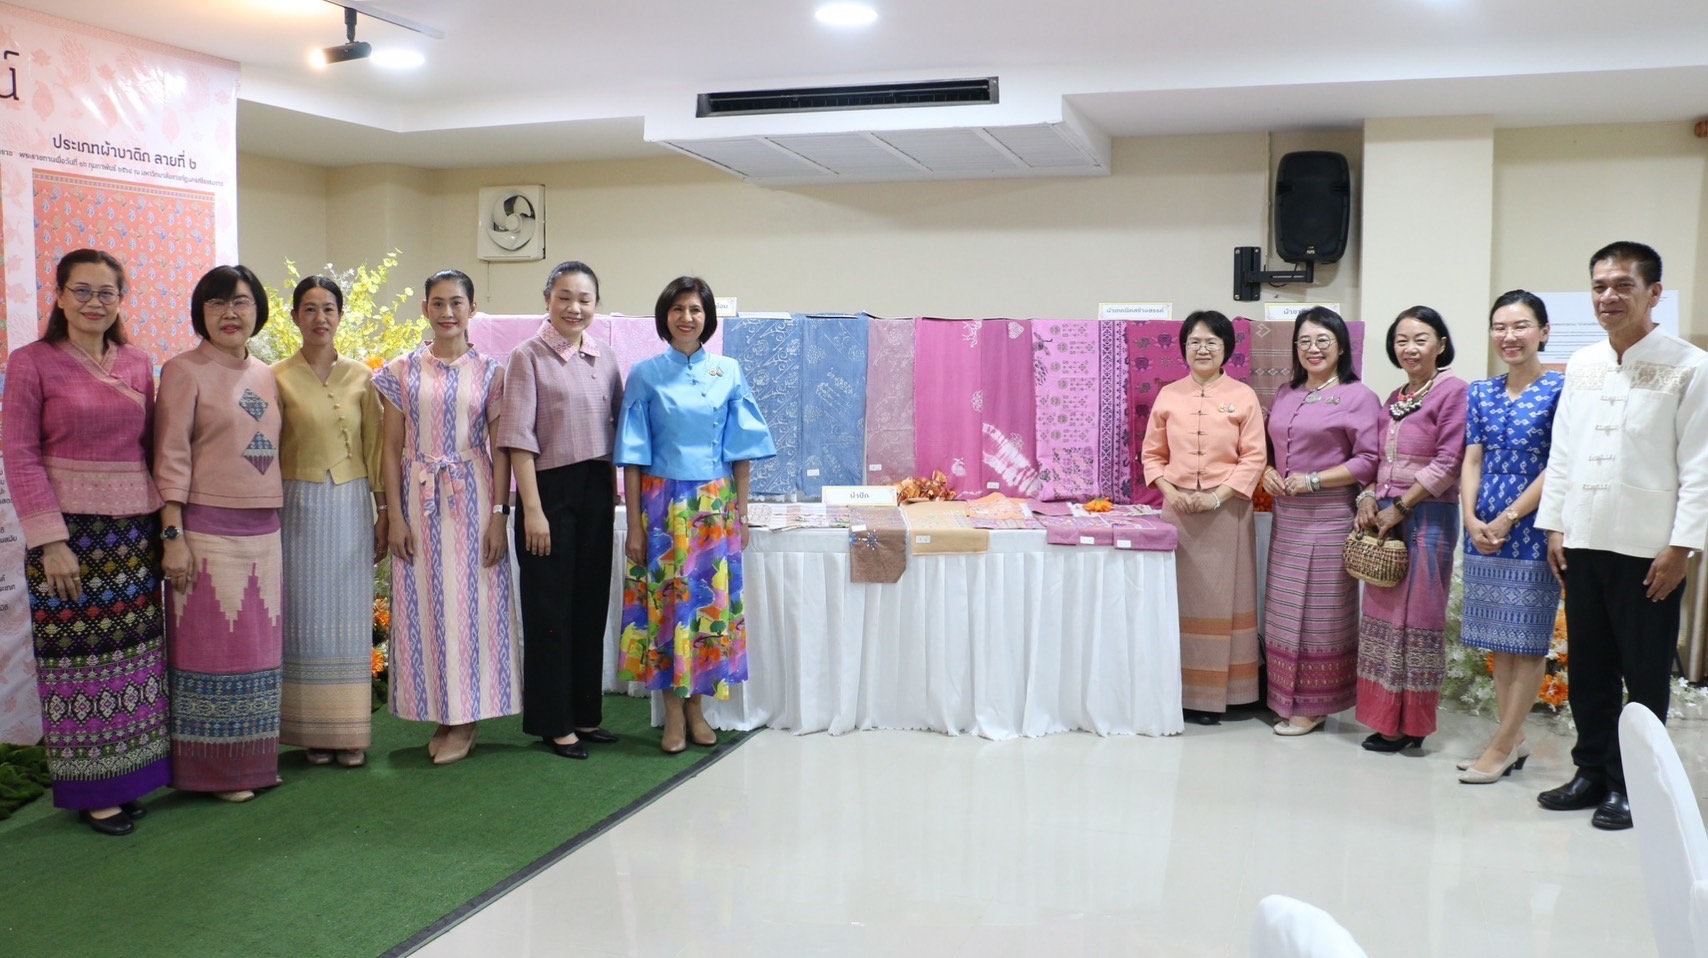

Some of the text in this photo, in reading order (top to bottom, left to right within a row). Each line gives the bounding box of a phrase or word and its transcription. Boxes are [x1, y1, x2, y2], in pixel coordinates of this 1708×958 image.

[53, 134, 151, 163] ประเภทผ้าบาติก
[154, 150, 186, 168] ลายที่
